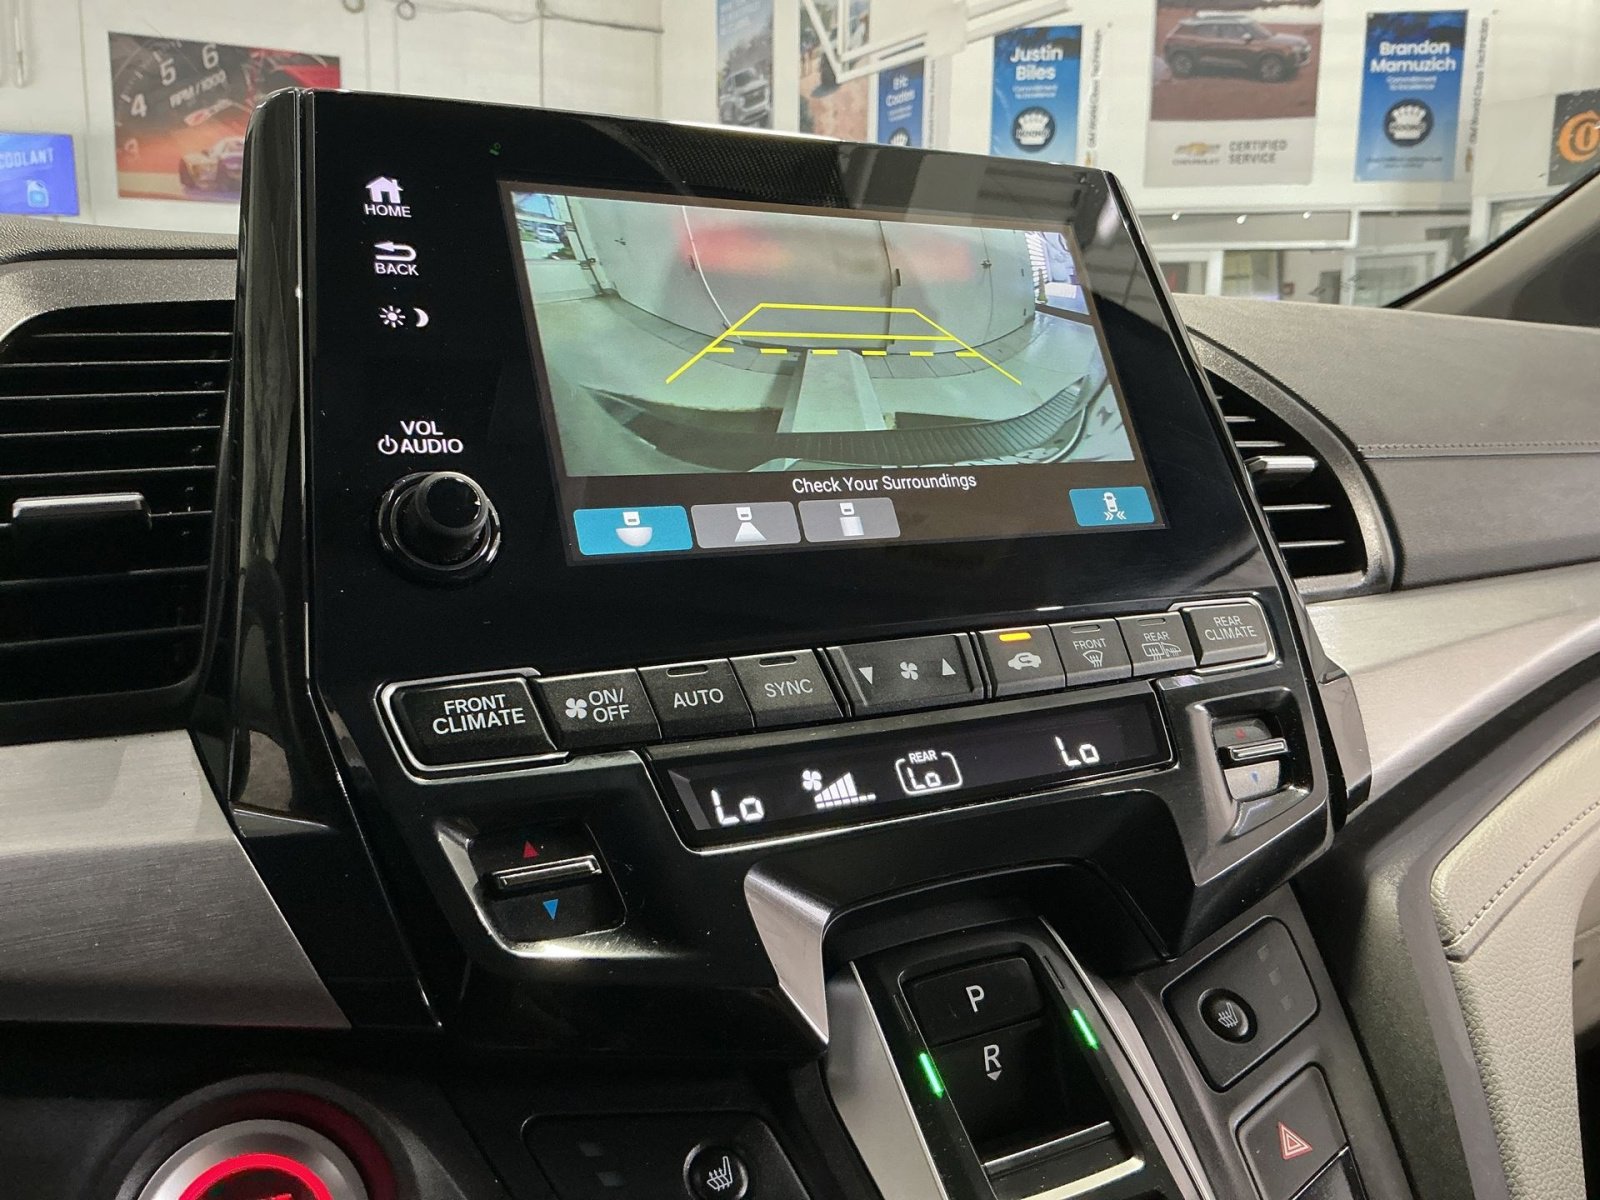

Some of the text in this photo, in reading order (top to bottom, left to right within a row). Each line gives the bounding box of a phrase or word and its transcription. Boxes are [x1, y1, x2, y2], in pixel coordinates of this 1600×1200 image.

[202, 43, 219, 70] 6
[1010, 44, 1063, 62] Justin
[1379, 40, 1450, 56] Brandon
[160, 58, 177, 86] 5
[1015, 64, 1056, 81] Biles
[1370, 57, 1456, 73] Mamuzich
[130, 93, 147, 117] 4
[1228, 139, 1288, 152] CERTIFIED
[0, 148, 54, 170] COOLANT
[1228, 153, 1276, 165] SERVICE
[364, 203, 412, 218] HOME
[374, 262, 419, 276] BACK
[400, 420, 444, 436] VOL
[400, 438, 464, 454] AUDIO
[792, 473, 977, 494] Check Your Surroundings
[1213, 616, 1243, 627] REAR
[1143, 631, 1170, 642] REAR
[1204, 625, 1258, 642] CLIMATE
[1072, 638, 1107, 650] FRONT
[588, 688, 624, 707] ON/
[764, 679, 814, 698] SYNC
[443, 694, 506, 716] FRONT
[672, 688, 724, 709] AUTO
[432, 707, 526, 736] CLIMATE
[592, 704, 630, 724] OFF
[908, 750, 938, 764] REAR
[1054, 736, 1101, 767] Lo
[906, 766, 942, 790] Lo
[710, 789, 766, 827] Lo
[965, 984, 985, 1013] P
[983, 1044, 1002, 1072] R
